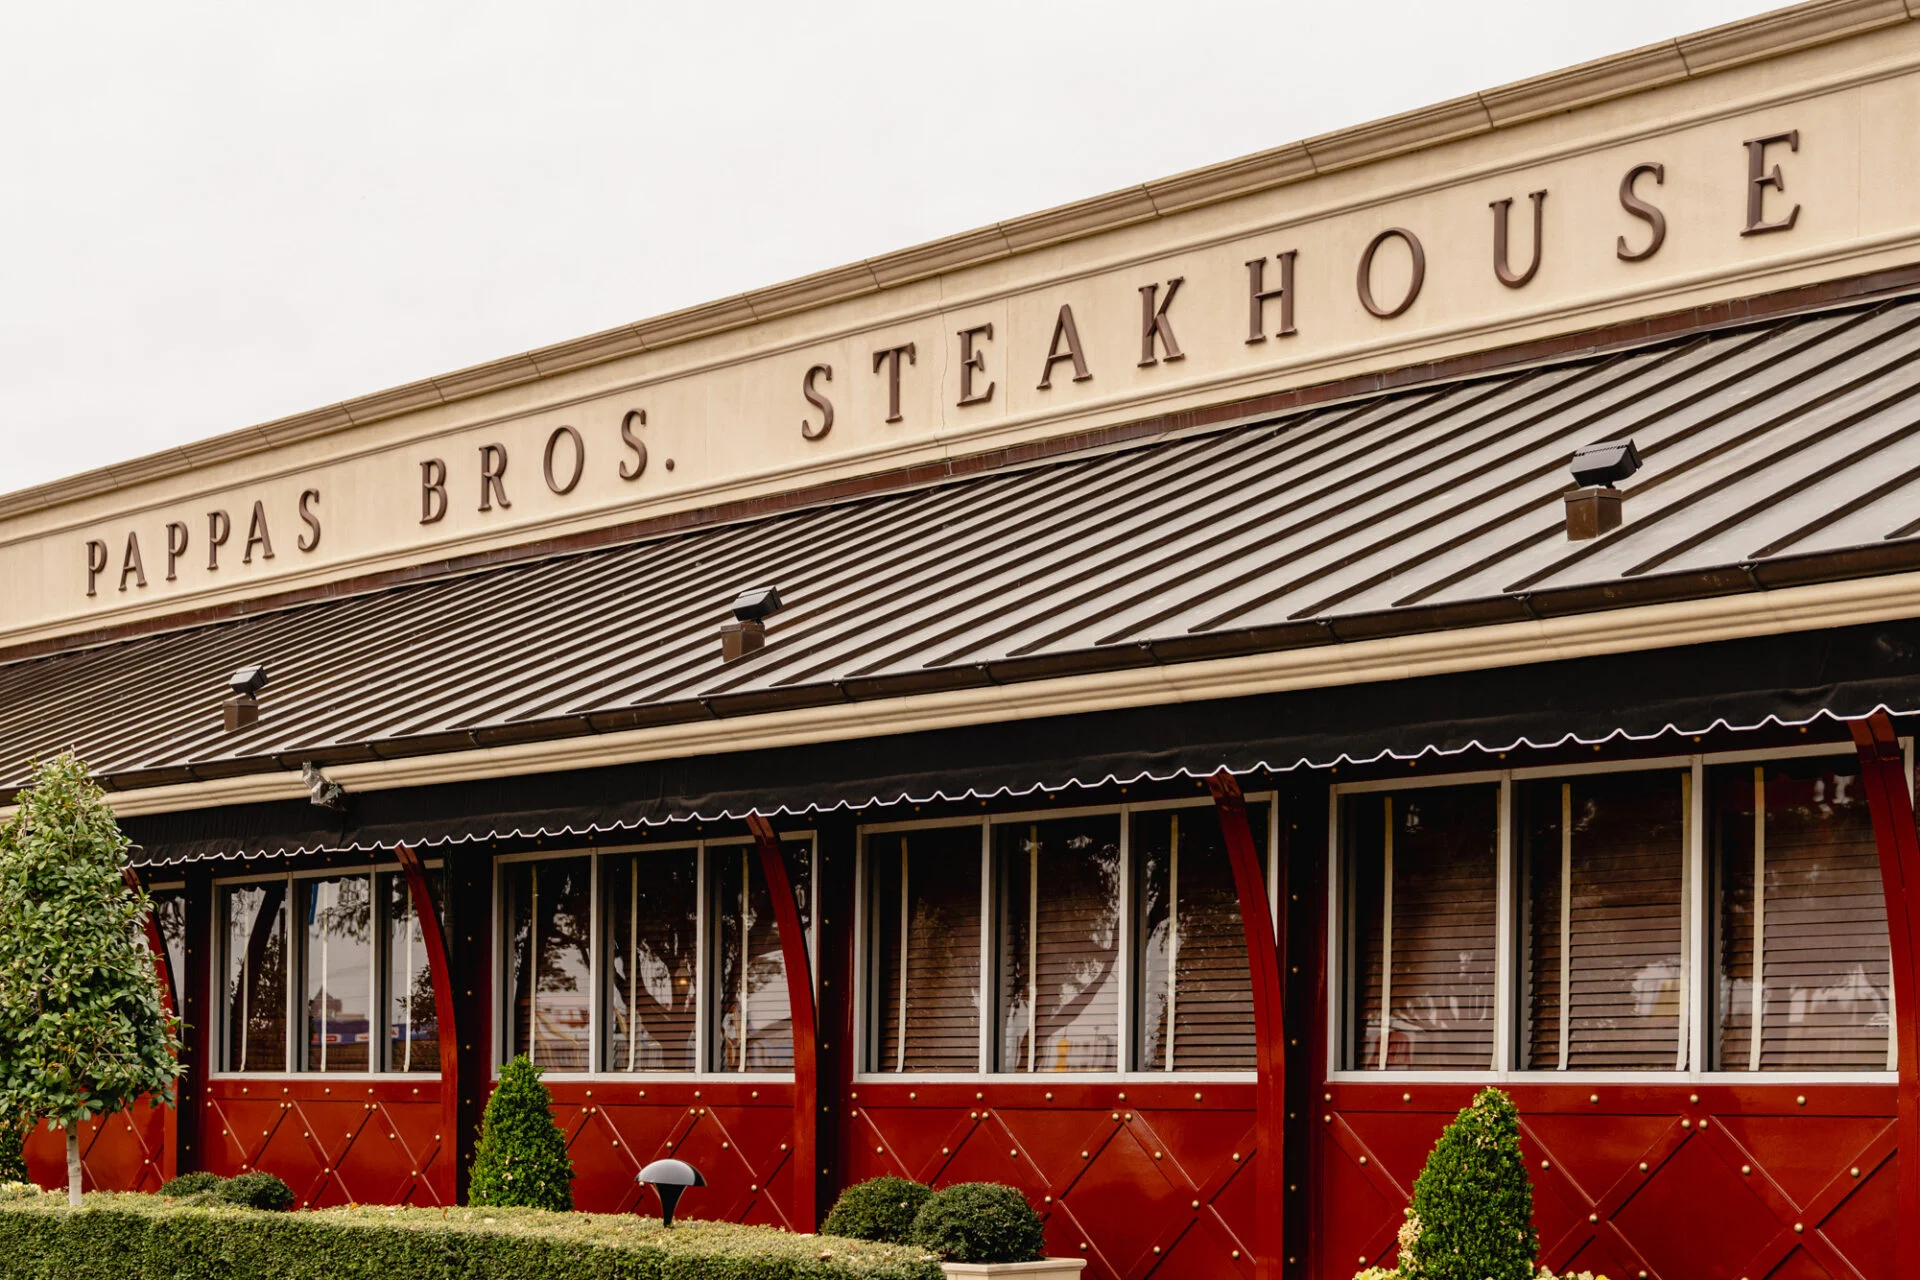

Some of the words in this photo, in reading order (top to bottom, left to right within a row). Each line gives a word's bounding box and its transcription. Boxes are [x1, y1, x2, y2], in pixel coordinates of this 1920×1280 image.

[86, 489, 321, 597] PAPPAS
[419, 408, 675, 525] BROS.
[801, 130, 1801, 441] STEAKHOUSE
